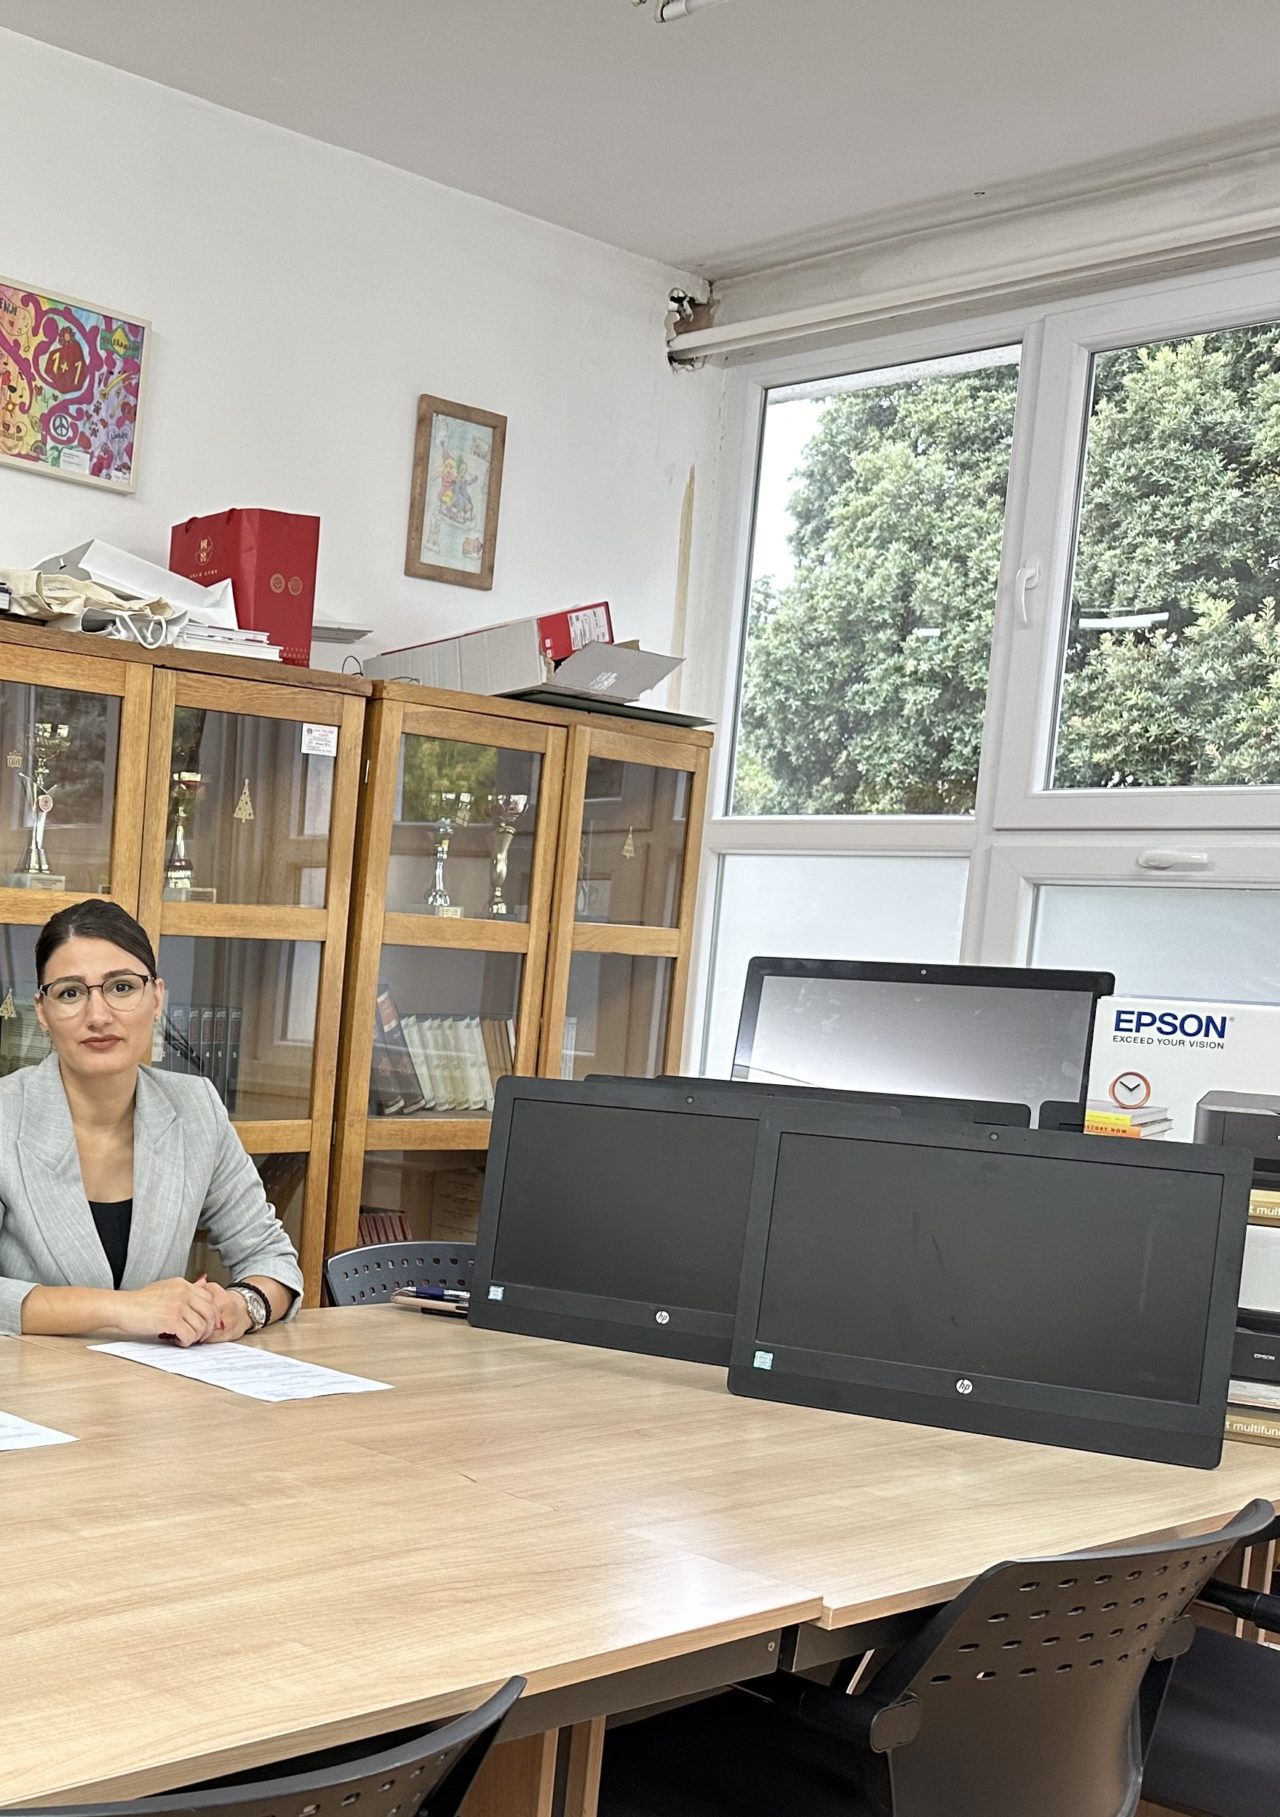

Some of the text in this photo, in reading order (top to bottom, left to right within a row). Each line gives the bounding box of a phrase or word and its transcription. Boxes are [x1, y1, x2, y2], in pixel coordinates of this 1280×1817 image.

[1114, 1010, 1227, 1038] EPSON
[1113, 1034, 1224, 1049] EXCEED YOUR VISION
[1254, 1353, 1275, 1361] EPSON
[1233, 1423, 1280, 1437] multifun
